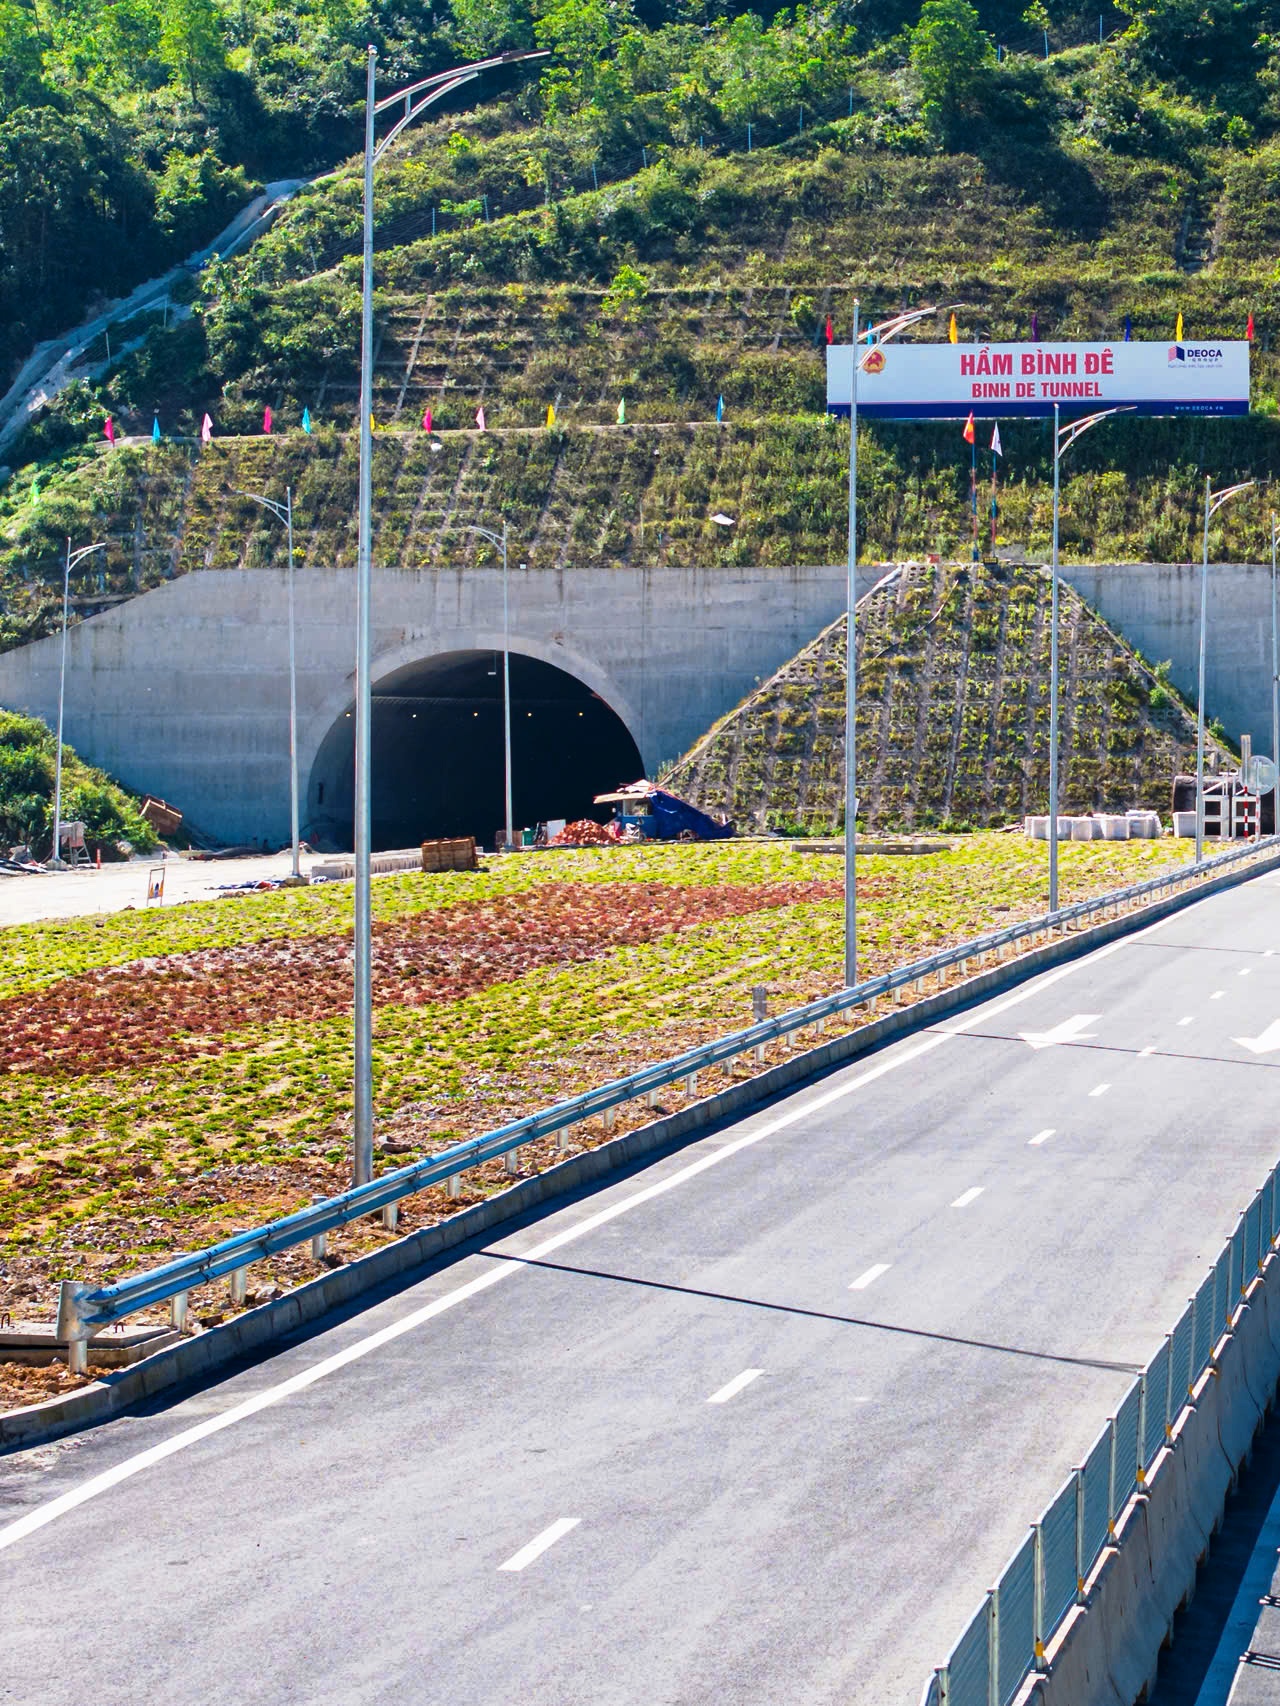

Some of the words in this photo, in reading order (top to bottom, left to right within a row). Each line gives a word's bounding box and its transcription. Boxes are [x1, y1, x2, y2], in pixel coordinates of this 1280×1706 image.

[960, 346, 1013, 376] HẦM
[1021, 348, 1077, 375] BÌNH
[1084, 348, 1114, 375] ĐÊ
[1187, 349, 1223, 358] DEOCA
[971, 382, 1010, 398] BINH
[1015, 382, 1036, 398] DE
[1041, 381, 1103, 397] TUNNEL
